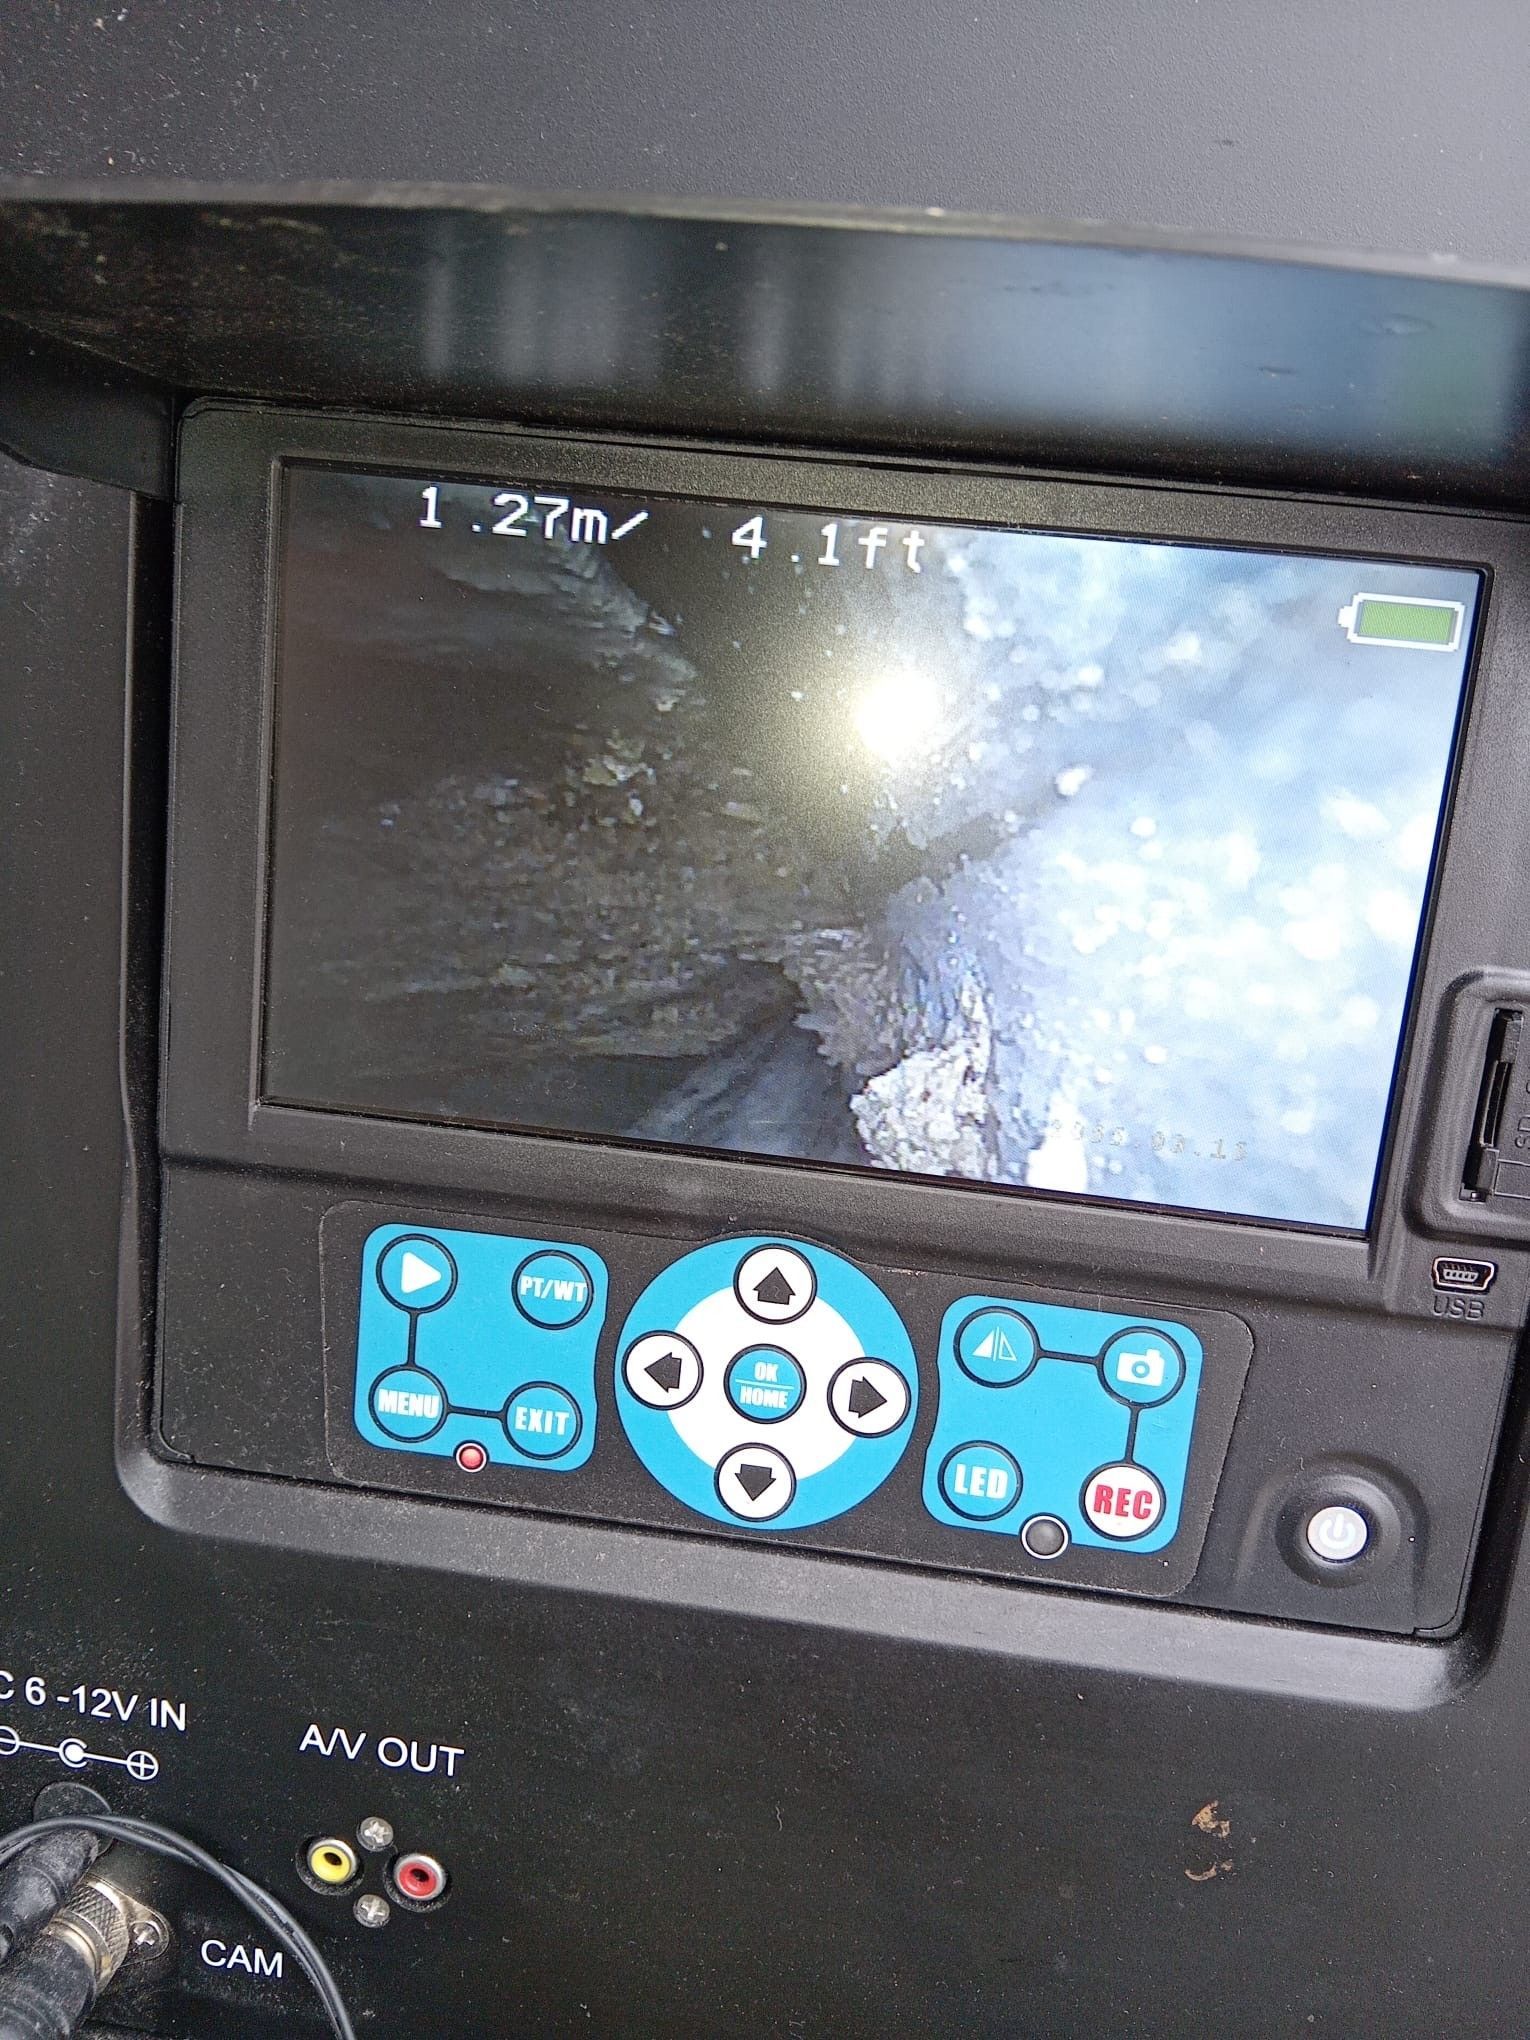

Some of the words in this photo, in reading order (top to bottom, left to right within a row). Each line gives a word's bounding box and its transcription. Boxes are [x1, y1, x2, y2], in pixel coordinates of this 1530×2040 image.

[519, 1275, 587, 1303] PT/WT
[1433, 1295, 1485, 1320] USB
[754, 1361, 779, 1383] OK
[378, 1389, 440, 1419] MENU
[739, 1384, 789, 1409] HOME
[515, 1406, 569, 1435] EXIT
[954, 1463, 1009, 1499] LED
[1093, 1484, 1153, 1520] REC
[150, 1697, 187, 1731] IN
[300, 1723, 367, 1761] A/V
[378, 1736, 465, 1777] OUT
[201, 1939, 283, 1978] CAM
